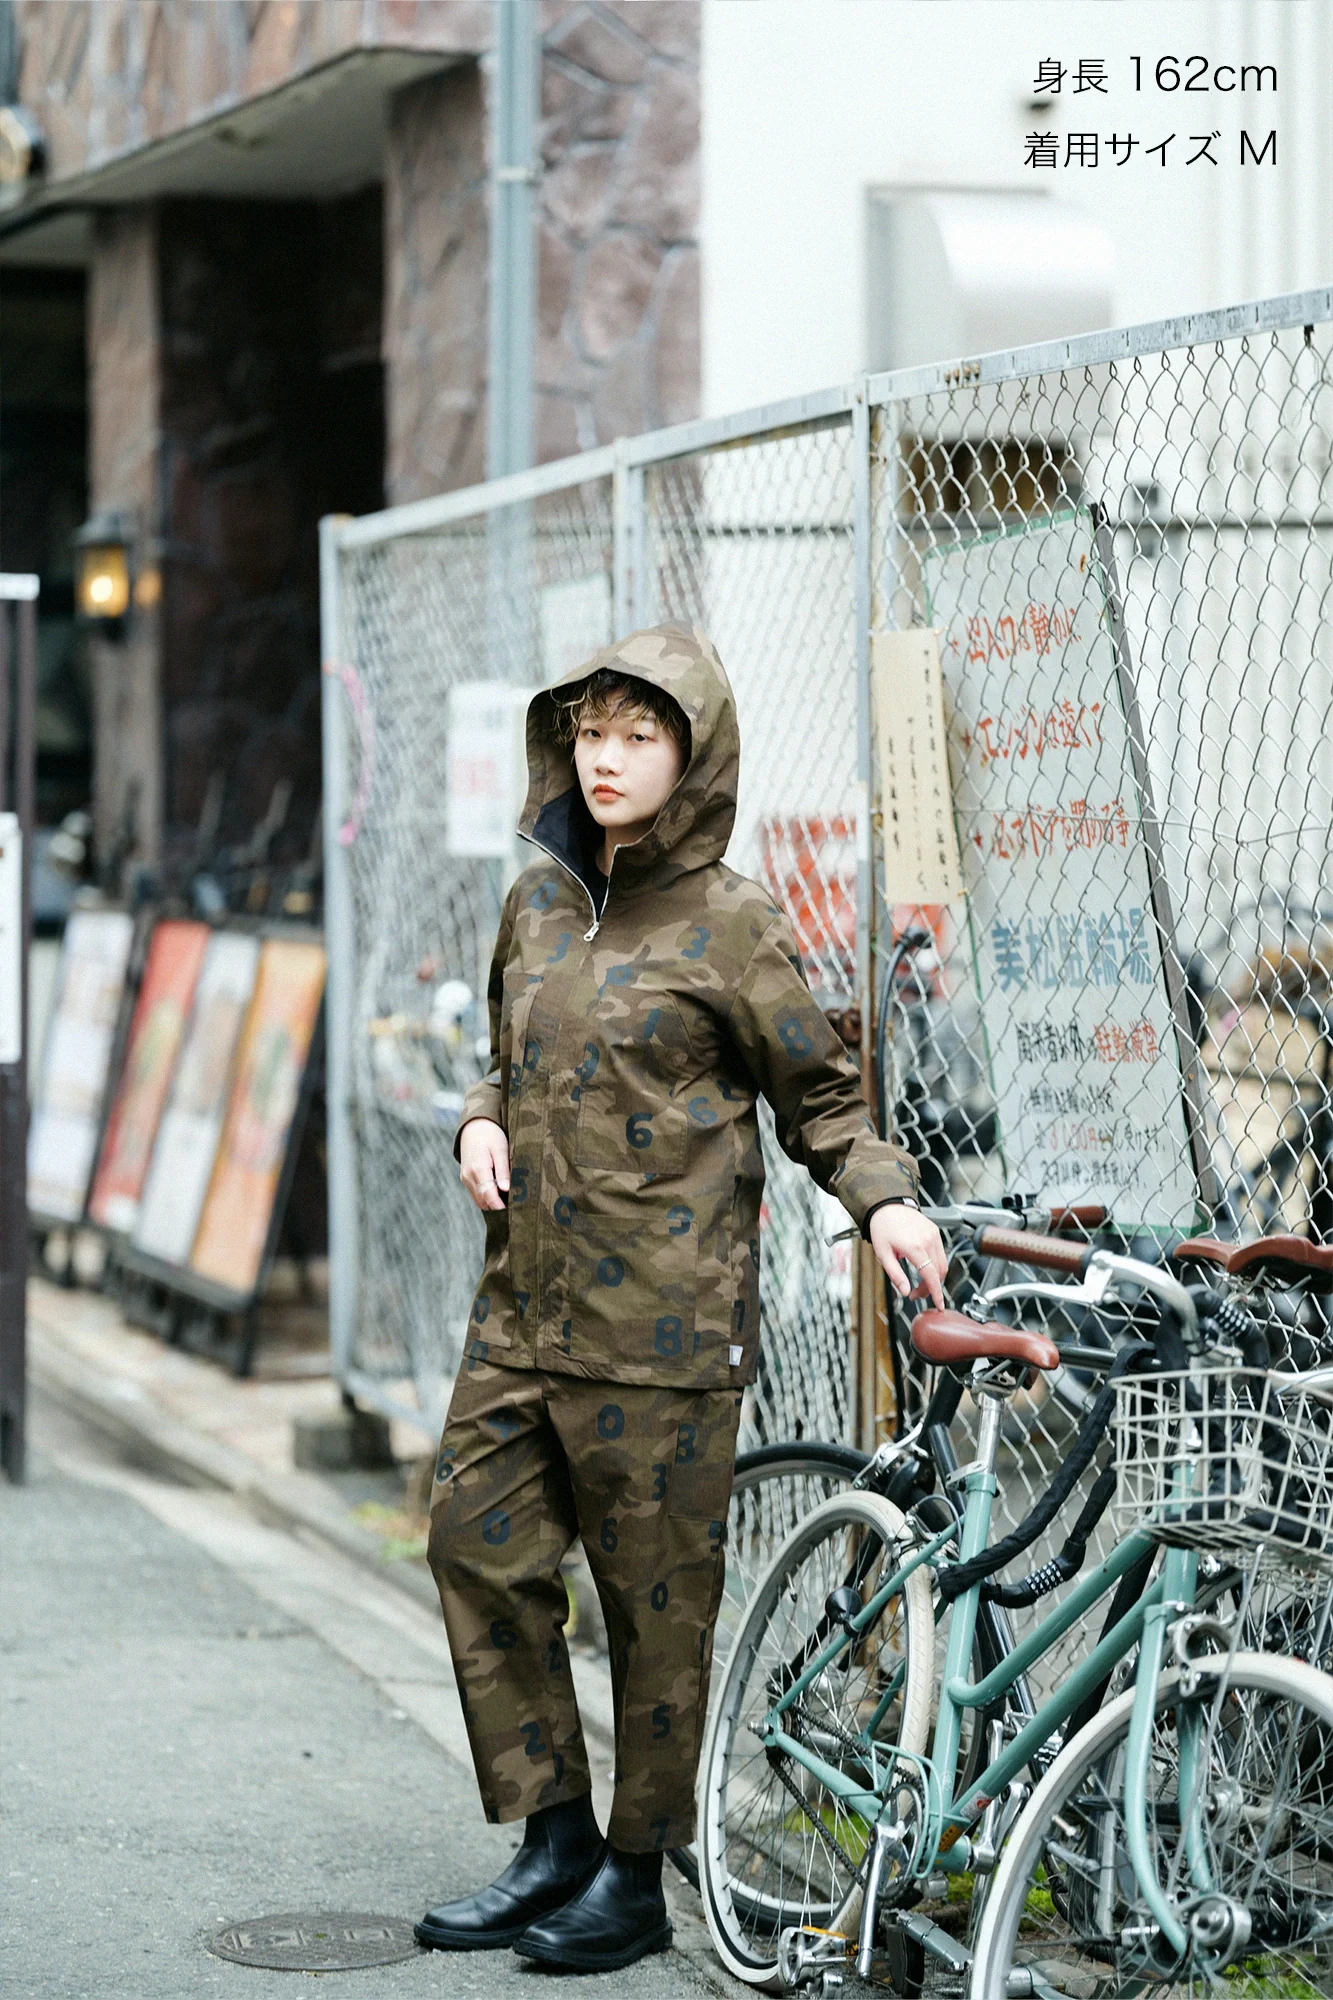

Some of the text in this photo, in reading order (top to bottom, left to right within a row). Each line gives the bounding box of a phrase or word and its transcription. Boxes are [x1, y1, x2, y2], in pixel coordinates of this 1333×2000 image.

[680, 927, 711, 959] 3
[991, 907, 1154, 993] 美松駐輪場
[778, 1017, 814, 1061] 8
[688, 1095, 718, 1125] 6
[625, 1112, 653, 1150] 6
[511, 1167, 530, 1203] 5
[597, 1256, 625, 1288] 0
[654, 1315, 683, 1357] 8
[597, 1404, 625, 1441] 0
[651, 1463, 667, 1501] 3
[482, 1510, 511, 1547] 0
[600, 1517, 619, 1553] 6
[651, 1581, 669, 1613] 0
[519, 1721, 547, 1757] 2
[652, 1704, 671, 1740] 5
